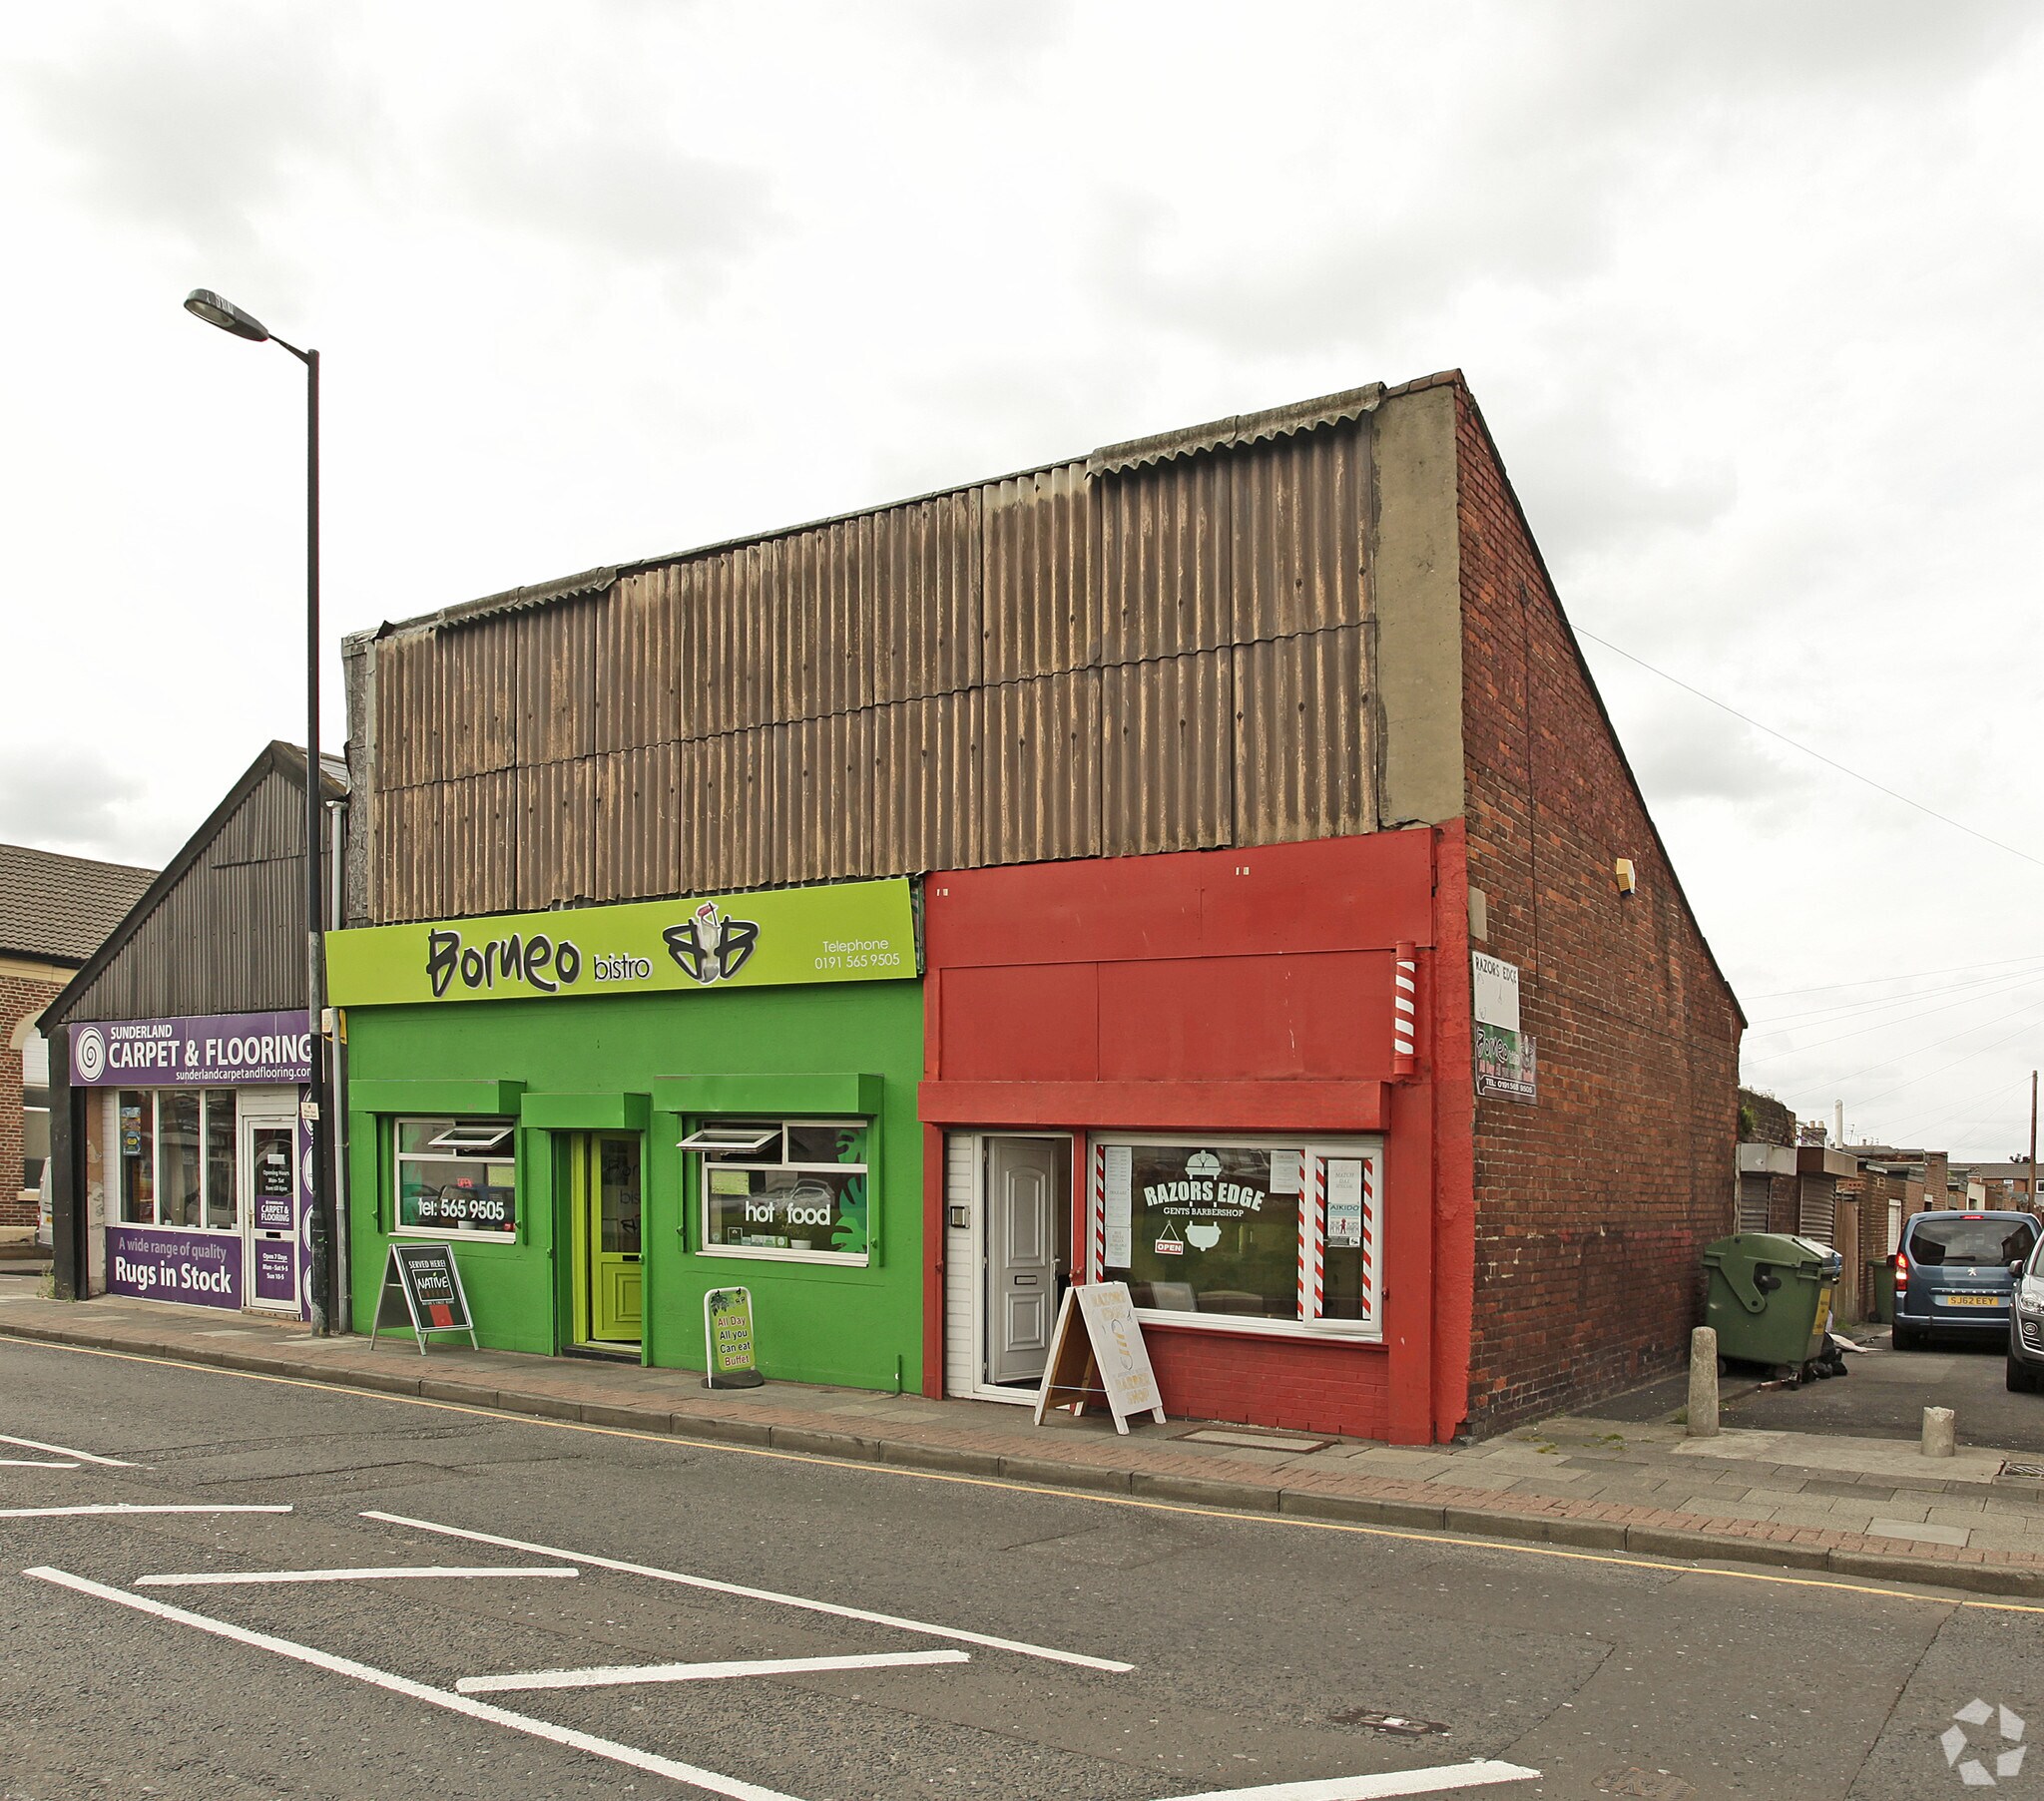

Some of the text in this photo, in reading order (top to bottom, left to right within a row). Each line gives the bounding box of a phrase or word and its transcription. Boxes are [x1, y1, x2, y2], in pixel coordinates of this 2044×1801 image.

[822, 939, 889, 954] Telephone
[426, 928, 653, 998] Borneo bistro
[814, 953, 900, 970] 0191 565 9505
[1475, 956, 1517, 984] RAZORS EDGE
[110, 1024, 173, 1041] SUNDERLAND
[108, 1034, 311, 1069] CARPET & FLOORING
[1143, 1180, 1266, 1211] RAZORS EDGE
[260, 1204, 289, 1214] CARPET &
[417, 1197, 505, 1220] tel: 565 9505
[745, 1200, 830, 1225] hot food
[1191, 1207, 1245, 1217] BARBERSHOP
[260, 1213, 289, 1222] FLOORING
[119, 1237, 227, 1263] A wide range of quality
[1157, 1243, 1182, 1252] OPEN
[408, 1260, 429, 1269] SERVED
[115, 1256, 233, 1294] Rugs in Stock
[417, 1276, 449, 1289] NATIVE
[718, 1316, 746, 1327] All Day
[720, 1330, 748, 1341] All you
[720, 1344, 737, 1353] Can
[725, 1355, 750, 1366] Buffet
